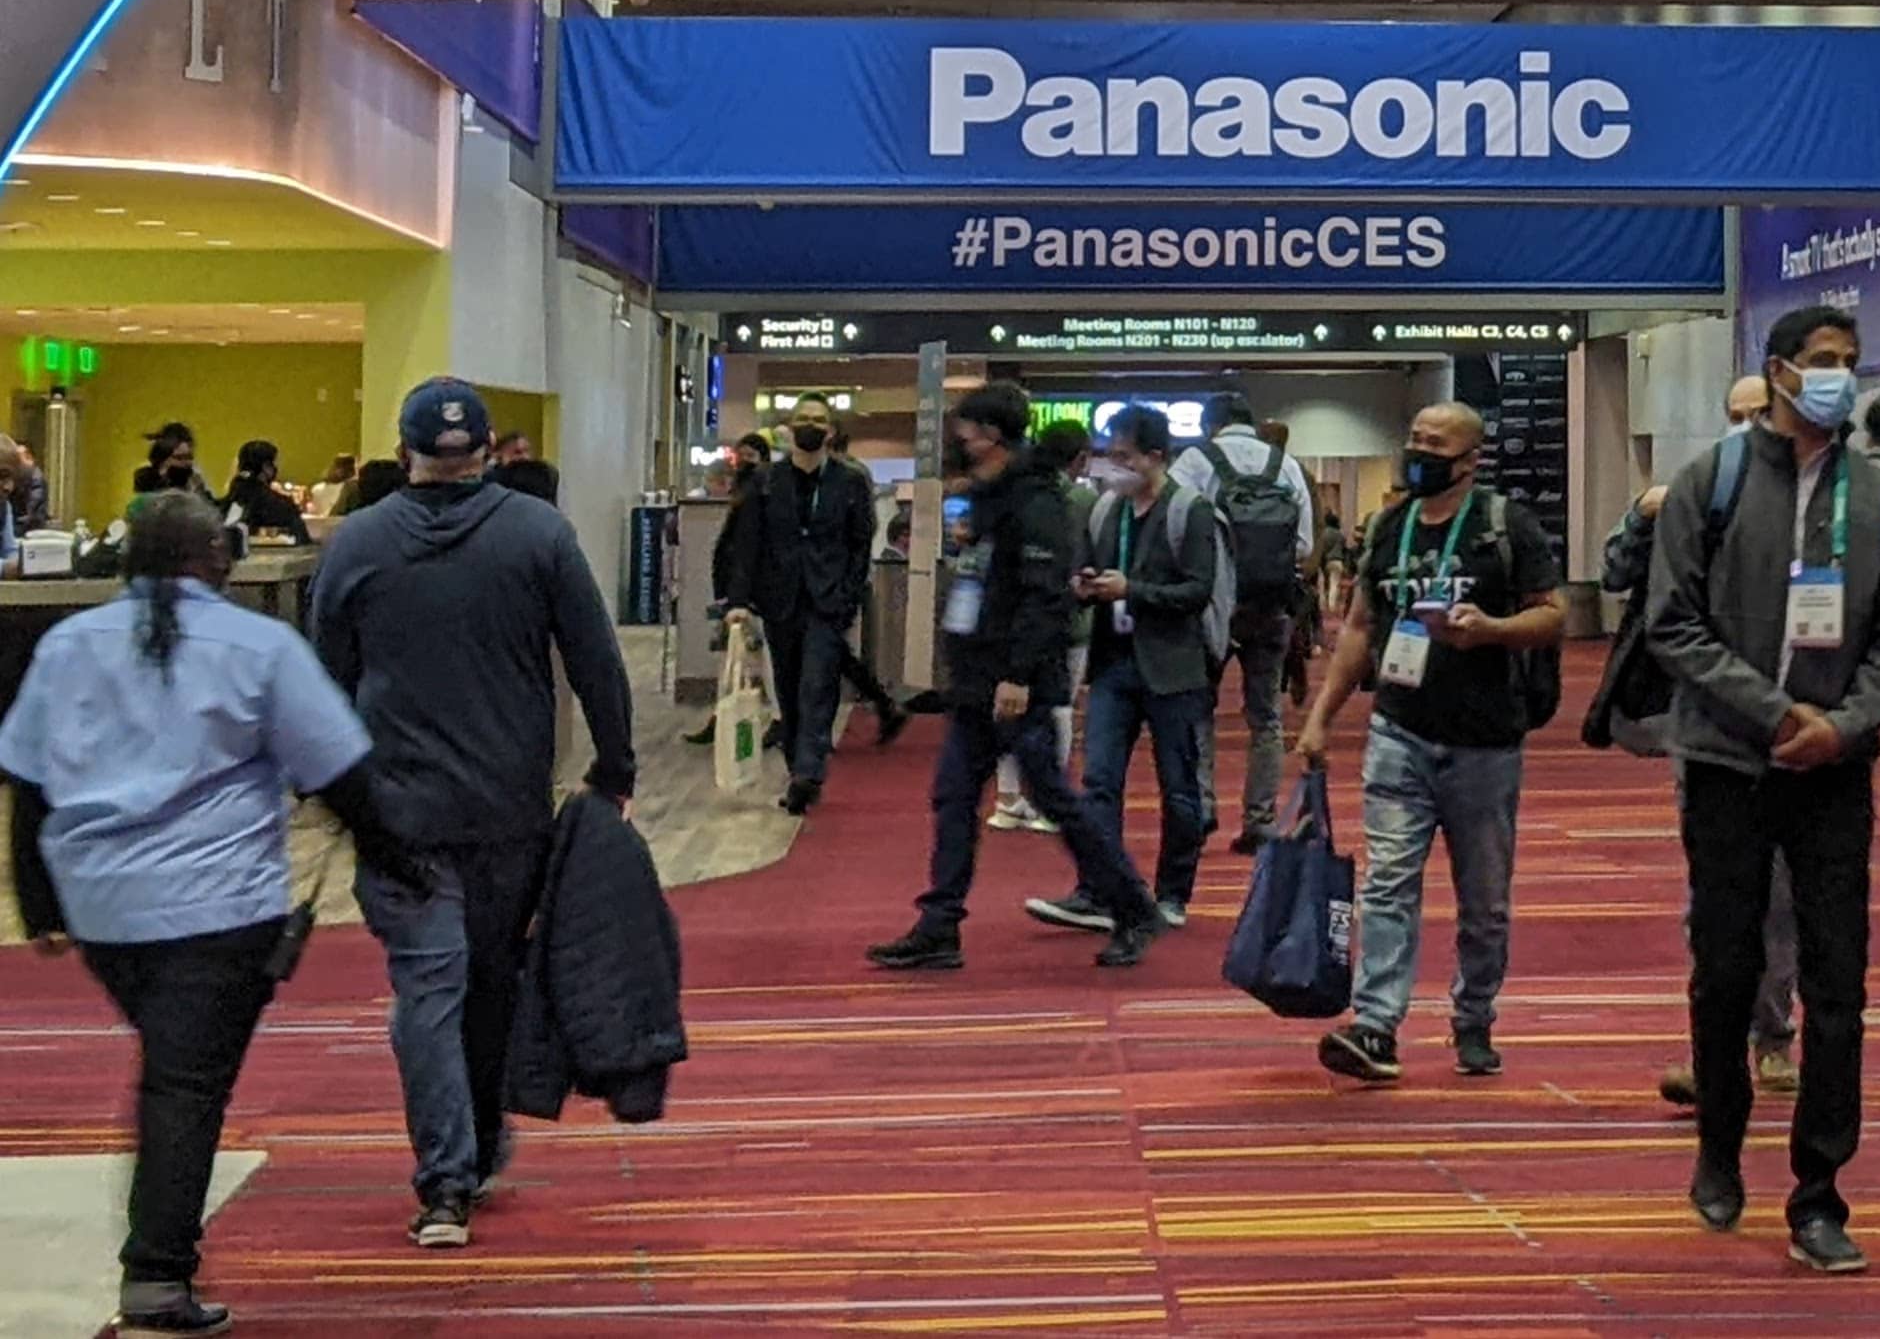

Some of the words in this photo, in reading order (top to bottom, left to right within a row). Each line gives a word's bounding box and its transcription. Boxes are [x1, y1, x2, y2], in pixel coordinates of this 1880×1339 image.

[928, 47, 1632, 159] Panasonic
[951, 216, 1447, 269] #PanasonicCES
[761, 318, 821, 334] Security
[1063, 317, 1122, 333] Meeting
[1124, 317, 1172, 331] Rooms
[1174, 317, 1209, 331] N101
[1220, 317, 1257, 331] N120
[1395, 324, 1444, 339] Exhibit
[1446, 324, 1479, 339] Halls
[1481, 325, 1503, 341] C3,
[1505, 325, 1528, 341] C4,
[1530, 325, 1549, 339] C5
[760, 335, 793, 348] First
[795, 334, 820, 348] Aid
[1016, 334, 1075, 350] Meeting
[1076, 334, 1123, 347] Rooms
[1125, 334, 1160, 347] N201
[1172, 334, 1208, 347] N230
[1210, 333, 1235, 350] (up
[1236, 333, 1306, 349] escalator)
